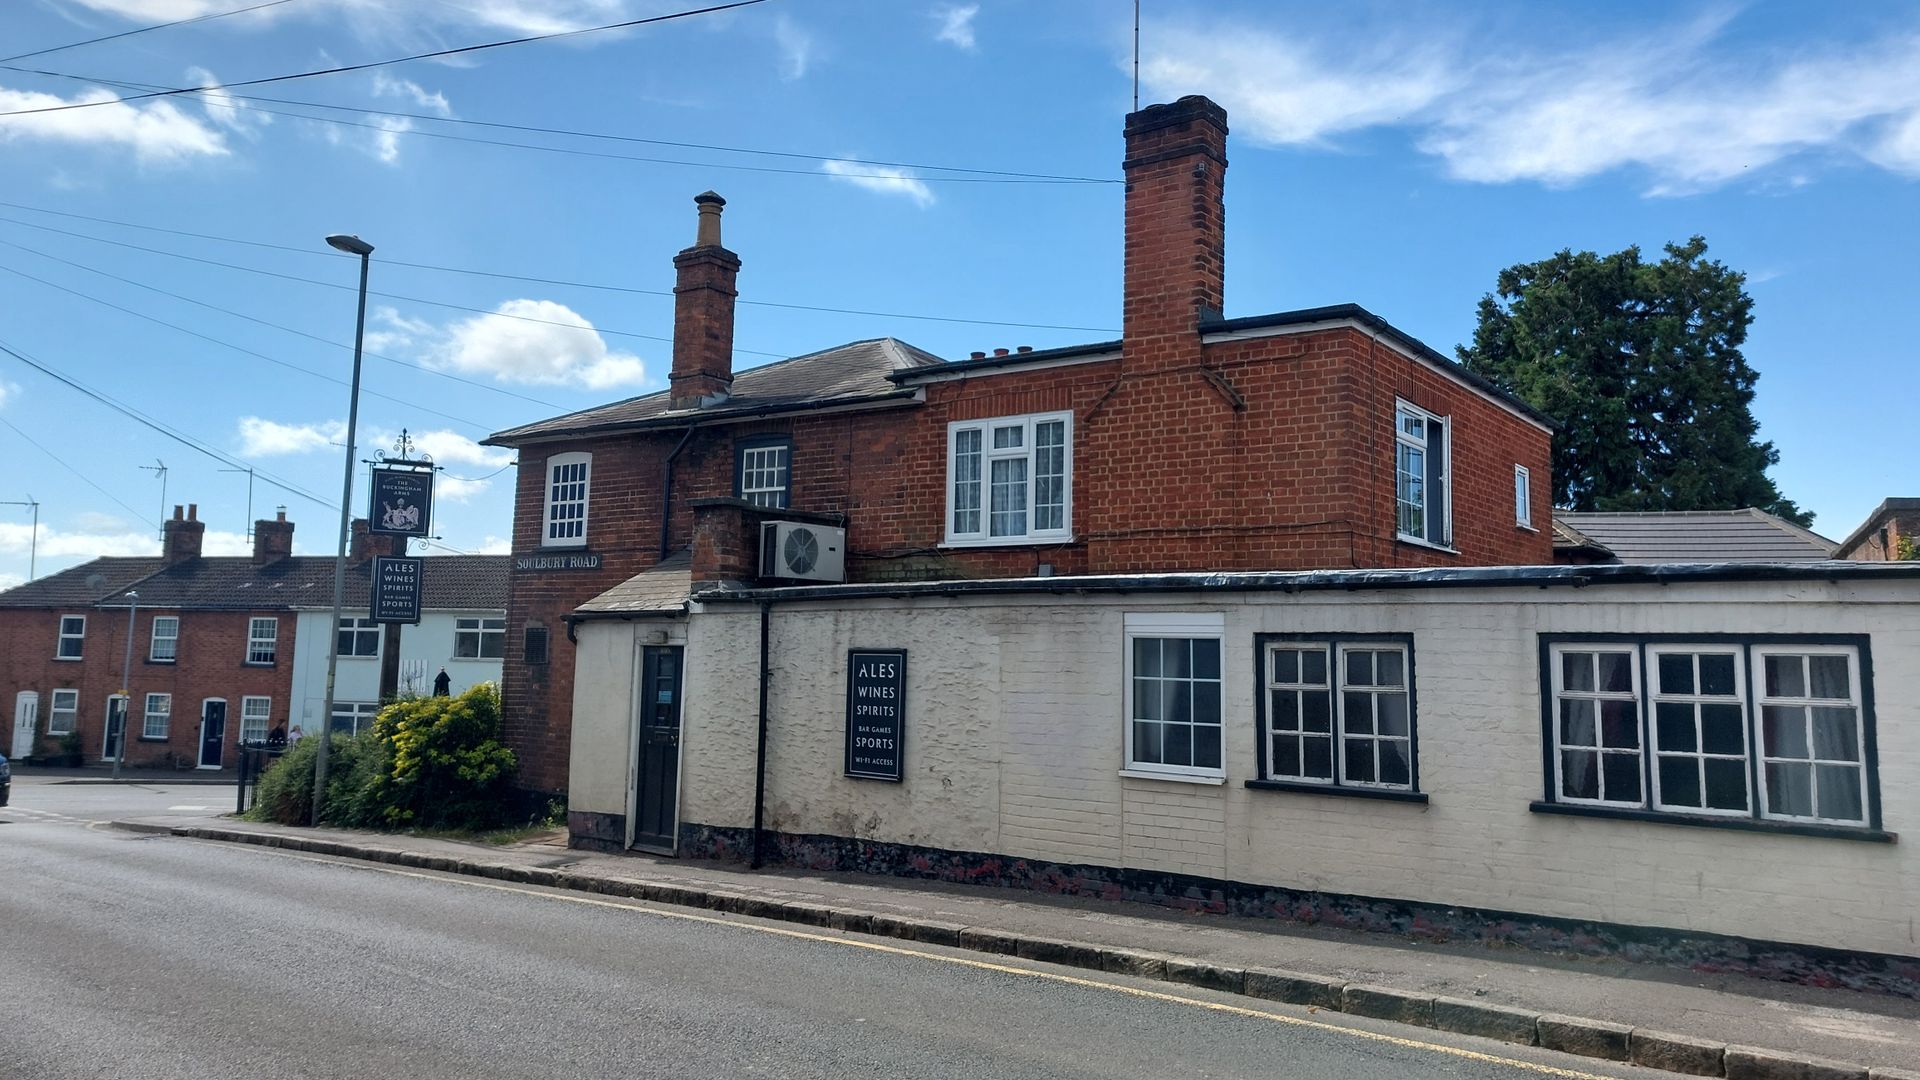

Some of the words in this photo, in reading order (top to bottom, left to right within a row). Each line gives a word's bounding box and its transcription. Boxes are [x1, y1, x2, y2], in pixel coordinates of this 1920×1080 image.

[382, 484, 422, 492] BUCKINGHAM
[516, 556, 567, 569] SOULBURY
[569, 555, 598, 568] ROAD
[385, 563, 415, 573] ALES
[384, 575, 415, 583] WINES
[383, 584, 414, 592] SPIRITS
[381, 600, 413, 608] SPORTS
[858, 663, 895, 679] ALES
[857, 686, 895, 699] WINES
[856, 704, 895, 717] SPIRITS
[858, 725, 870, 733] BAR
[871, 726, 892, 734] GAMES
[855, 736, 894, 750] SPORTS
[855, 756, 871, 764] WI-FI
[872, 757, 894, 766] ACCESS
